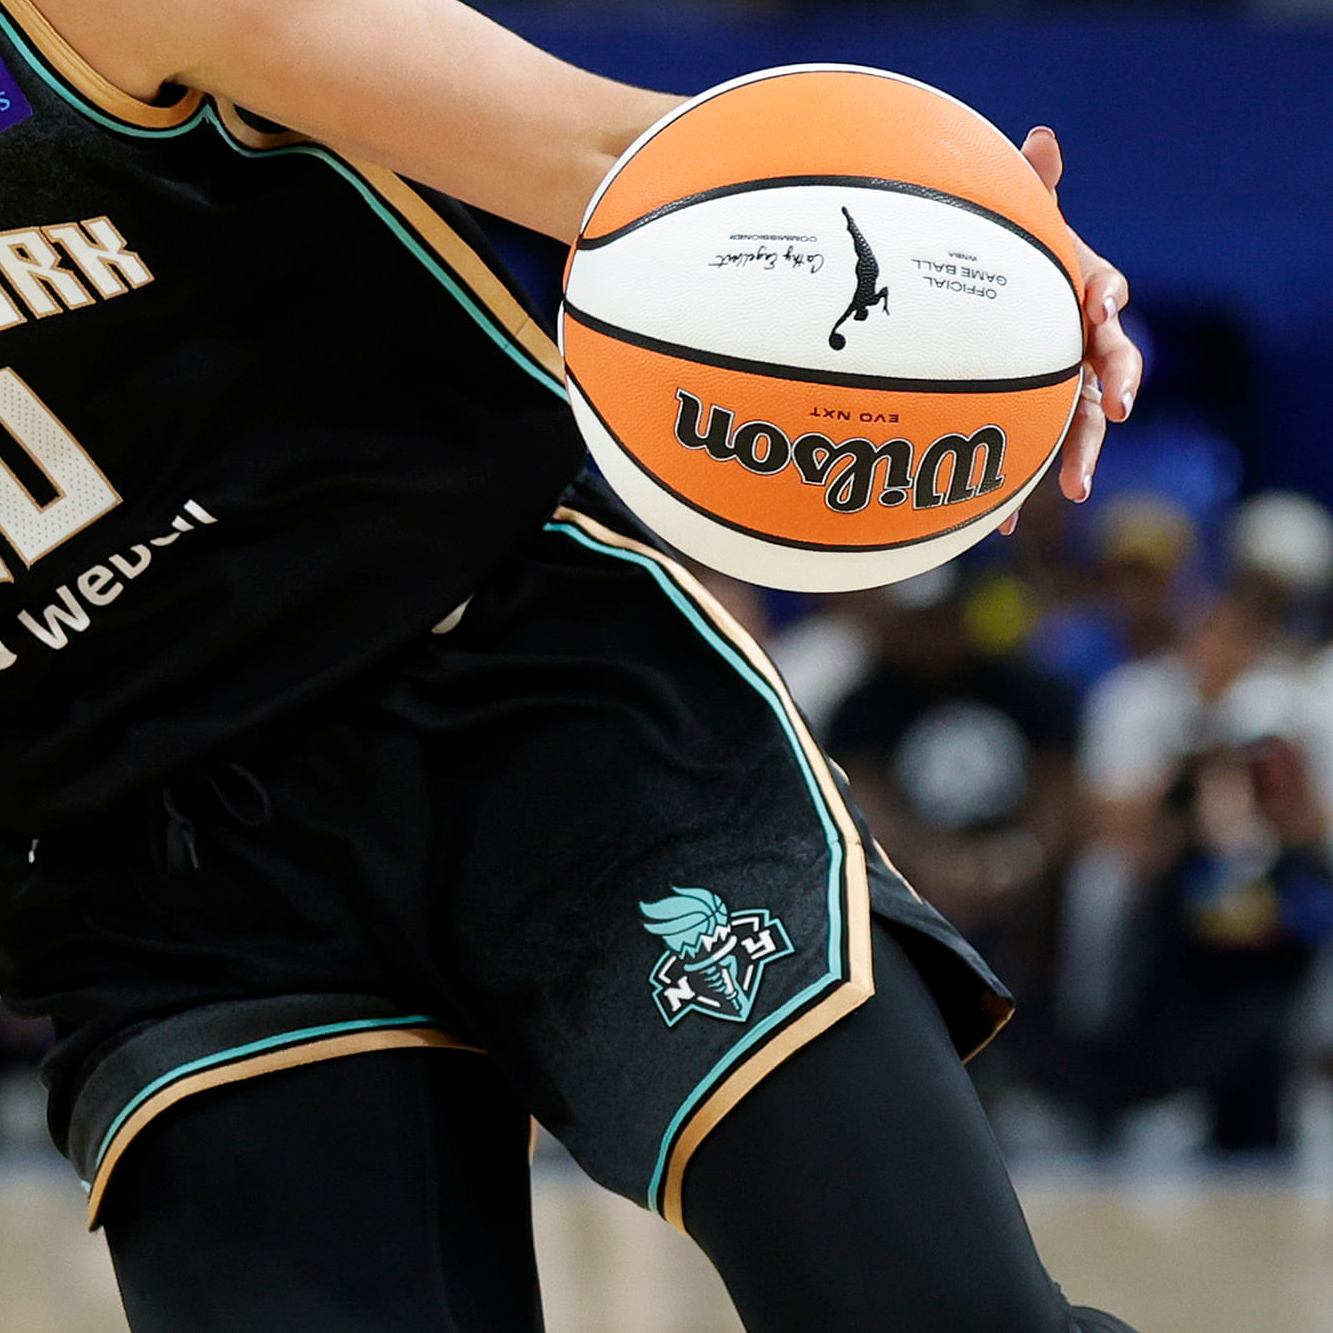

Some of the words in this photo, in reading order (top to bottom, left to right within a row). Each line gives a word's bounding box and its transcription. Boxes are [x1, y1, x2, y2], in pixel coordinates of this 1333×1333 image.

[948, 251, 978, 262] WNBA
[911, 258, 958, 275] BALL
[960, 266, 1008, 287] GAME
[922, 276, 998, 300] OFFICIAL
[809, 406, 851, 421] NXT
[859, 412, 900, 423] EVO
[674, 390, 1009, 513] Wilson
